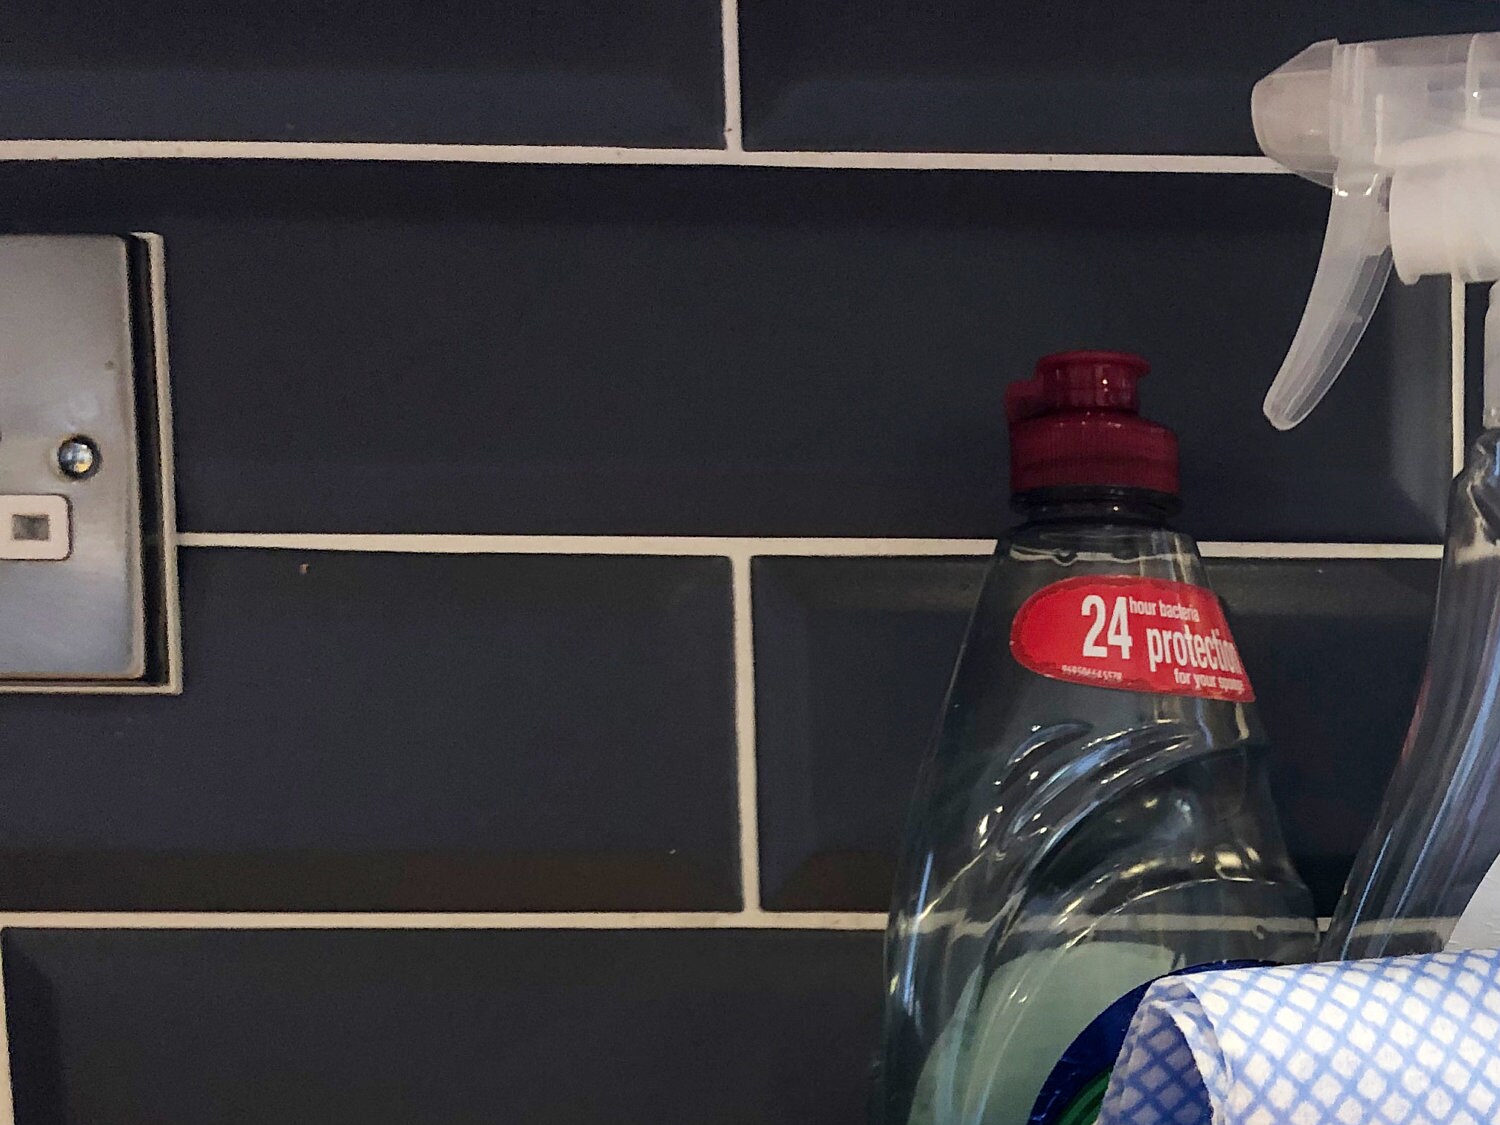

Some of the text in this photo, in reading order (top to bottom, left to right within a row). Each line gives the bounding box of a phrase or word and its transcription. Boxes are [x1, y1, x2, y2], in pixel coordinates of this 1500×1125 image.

[1129, 596, 1200, 622] hour bacteria
[1081, 595, 1133, 660] 24
[1173, 668, 1191, 685] for
[1193, 673, 1218, 690] your
